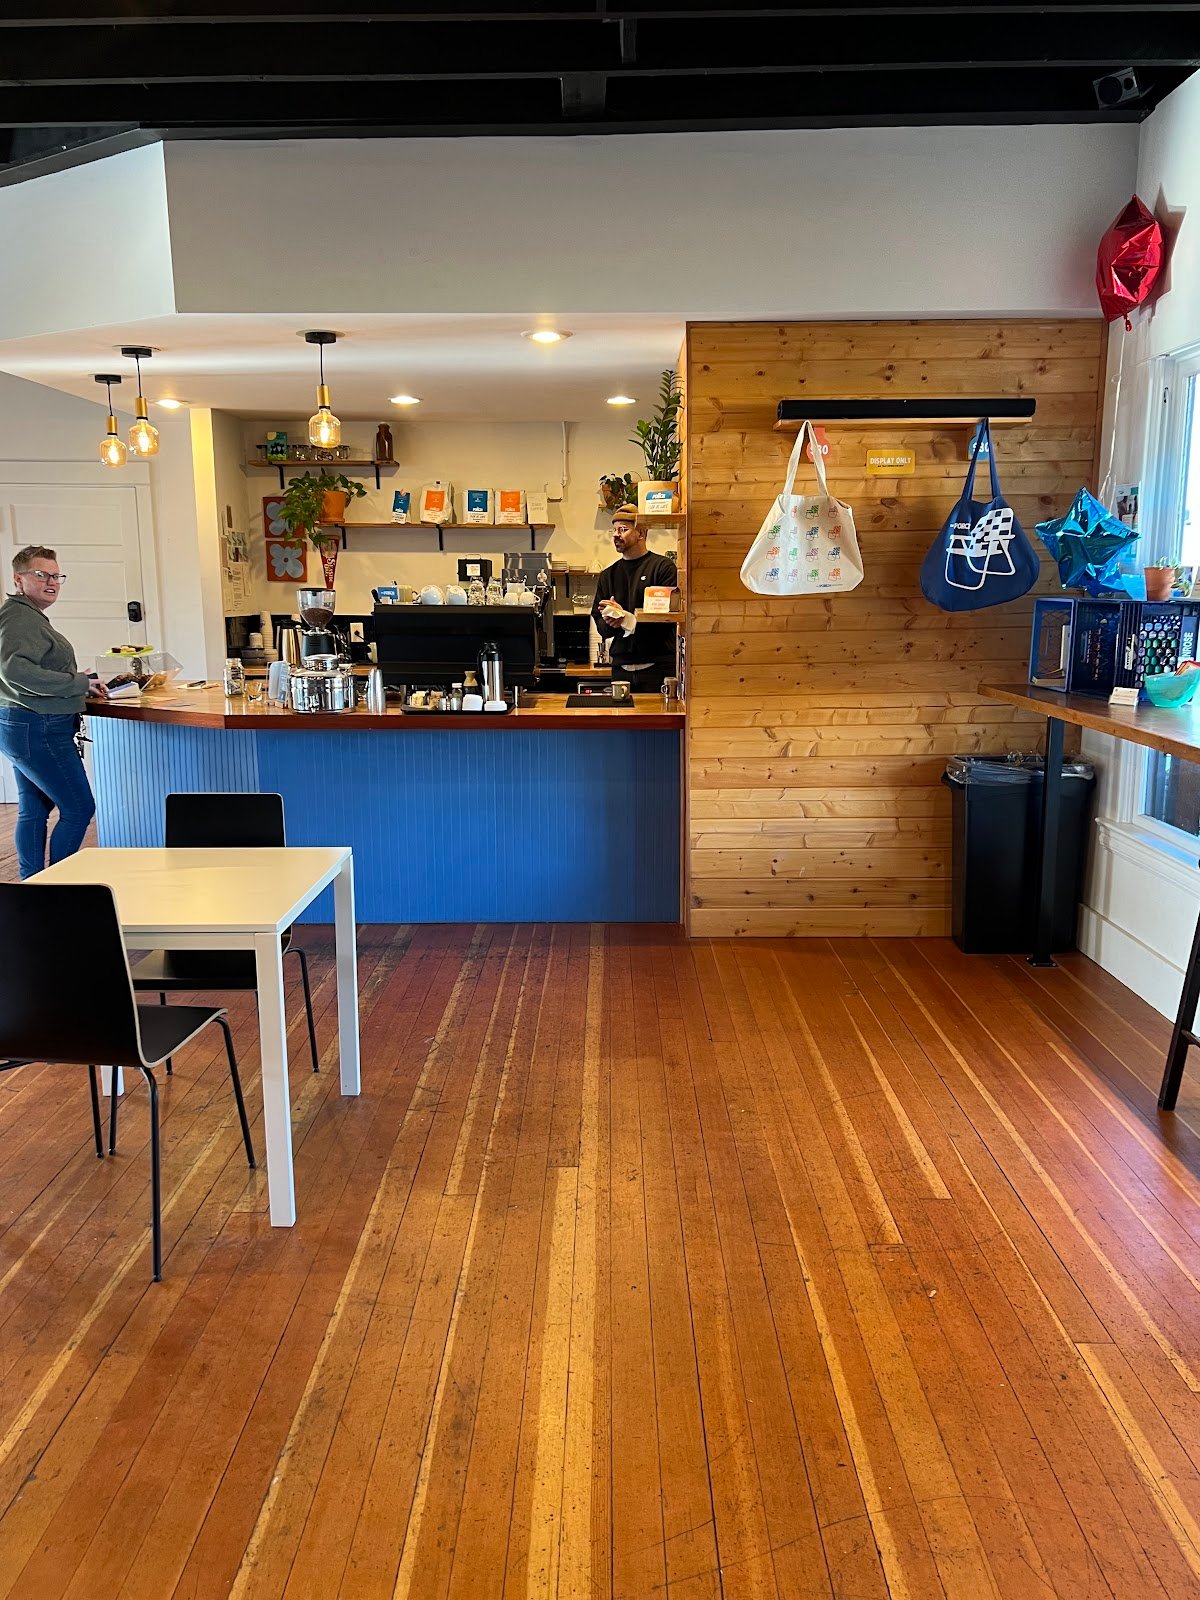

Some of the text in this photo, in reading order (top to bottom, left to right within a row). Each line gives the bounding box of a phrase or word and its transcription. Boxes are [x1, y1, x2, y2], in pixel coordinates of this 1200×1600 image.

[870, 456, 912, 465] DISPLAY ONLY
[1182, 632, 1194, 657] NROSE
